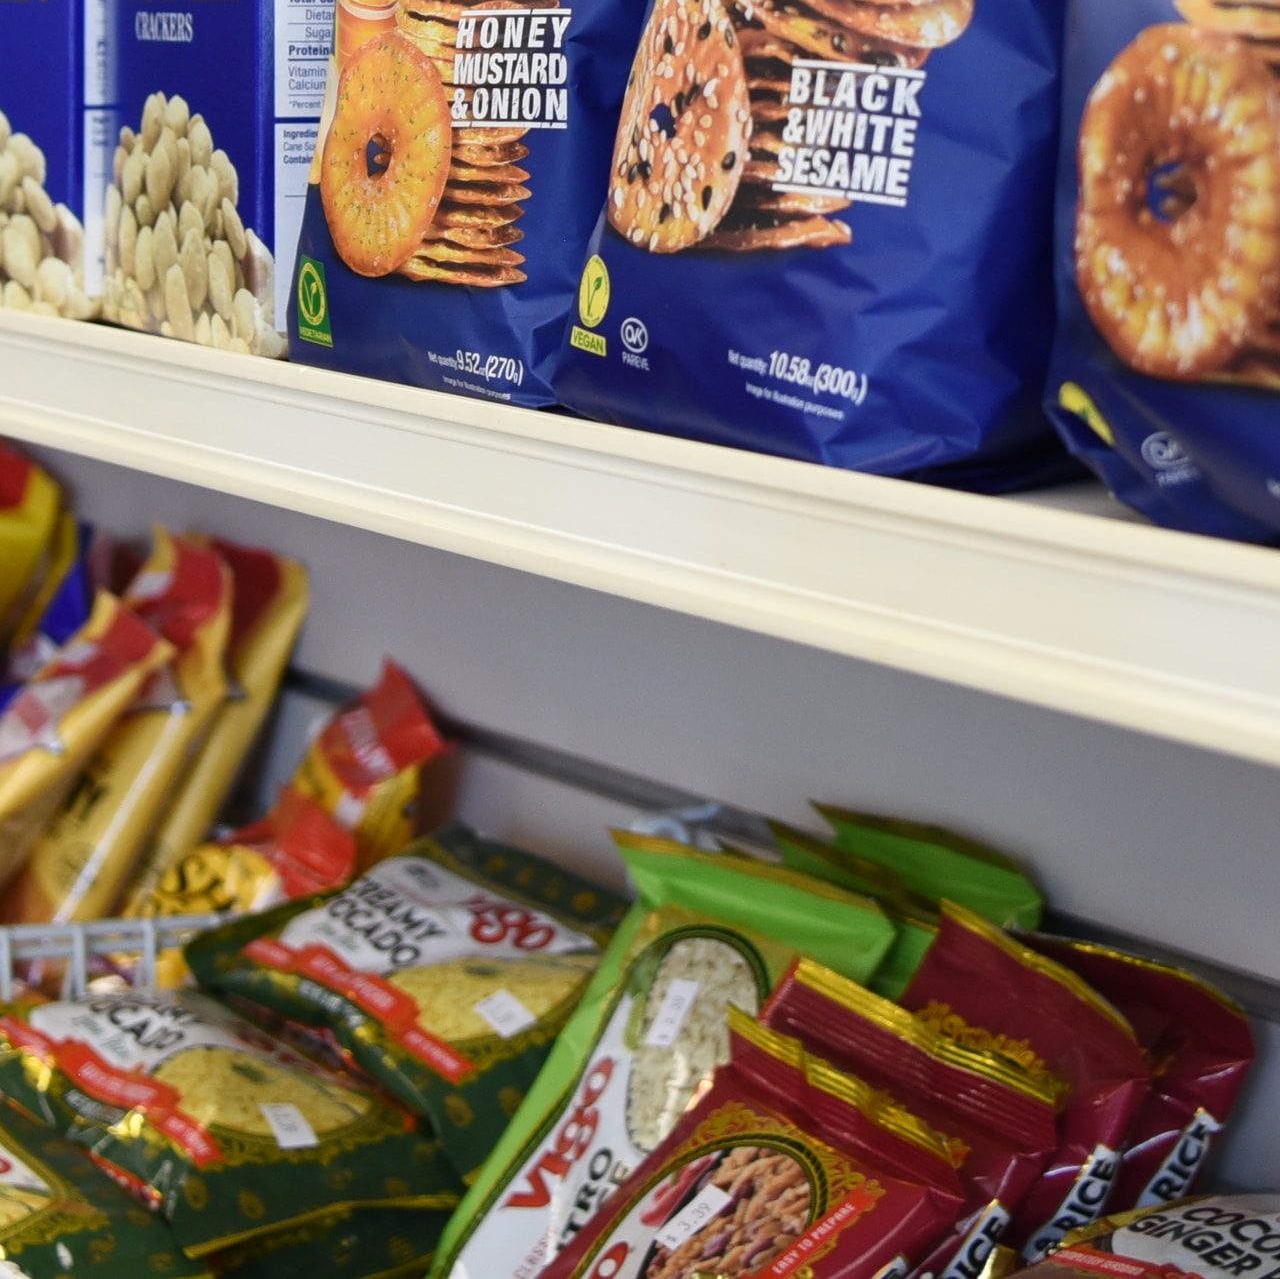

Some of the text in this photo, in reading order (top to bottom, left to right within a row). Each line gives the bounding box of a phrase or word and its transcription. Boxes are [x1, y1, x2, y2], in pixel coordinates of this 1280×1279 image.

[135, 11, 193, 42] CRACKERS
[305, 9, 335, 20] Dieta
[305, 27, 332, 40] Suga
[455, 16, 571, 49] HONEY
[288, 45, 329, 56] Protein
[288, 67, 327, 77] Vitamin
[453, 53, 568, 85] MUSTARD
[451, 87, 568, 121] & ONION
[789, 67, 924, 118] BLACK
[283, 129, 317, 139] Ingredie
[283, 141, 303, 151] Cane
[782, 107, 918, 157] & WHITE
[775, 146, 912, 196] SESAME
[573, 328, 605, 354] VEGAN
[728, 349, 739, 365] Net
[327, 895, 421, 967] OCADO
[684, 1201, 711, 1232] 3.39
[772, 1202, 857, 1275] EASY TO PREPARE
[1127, 1214, 1263, 1272] GINGER
